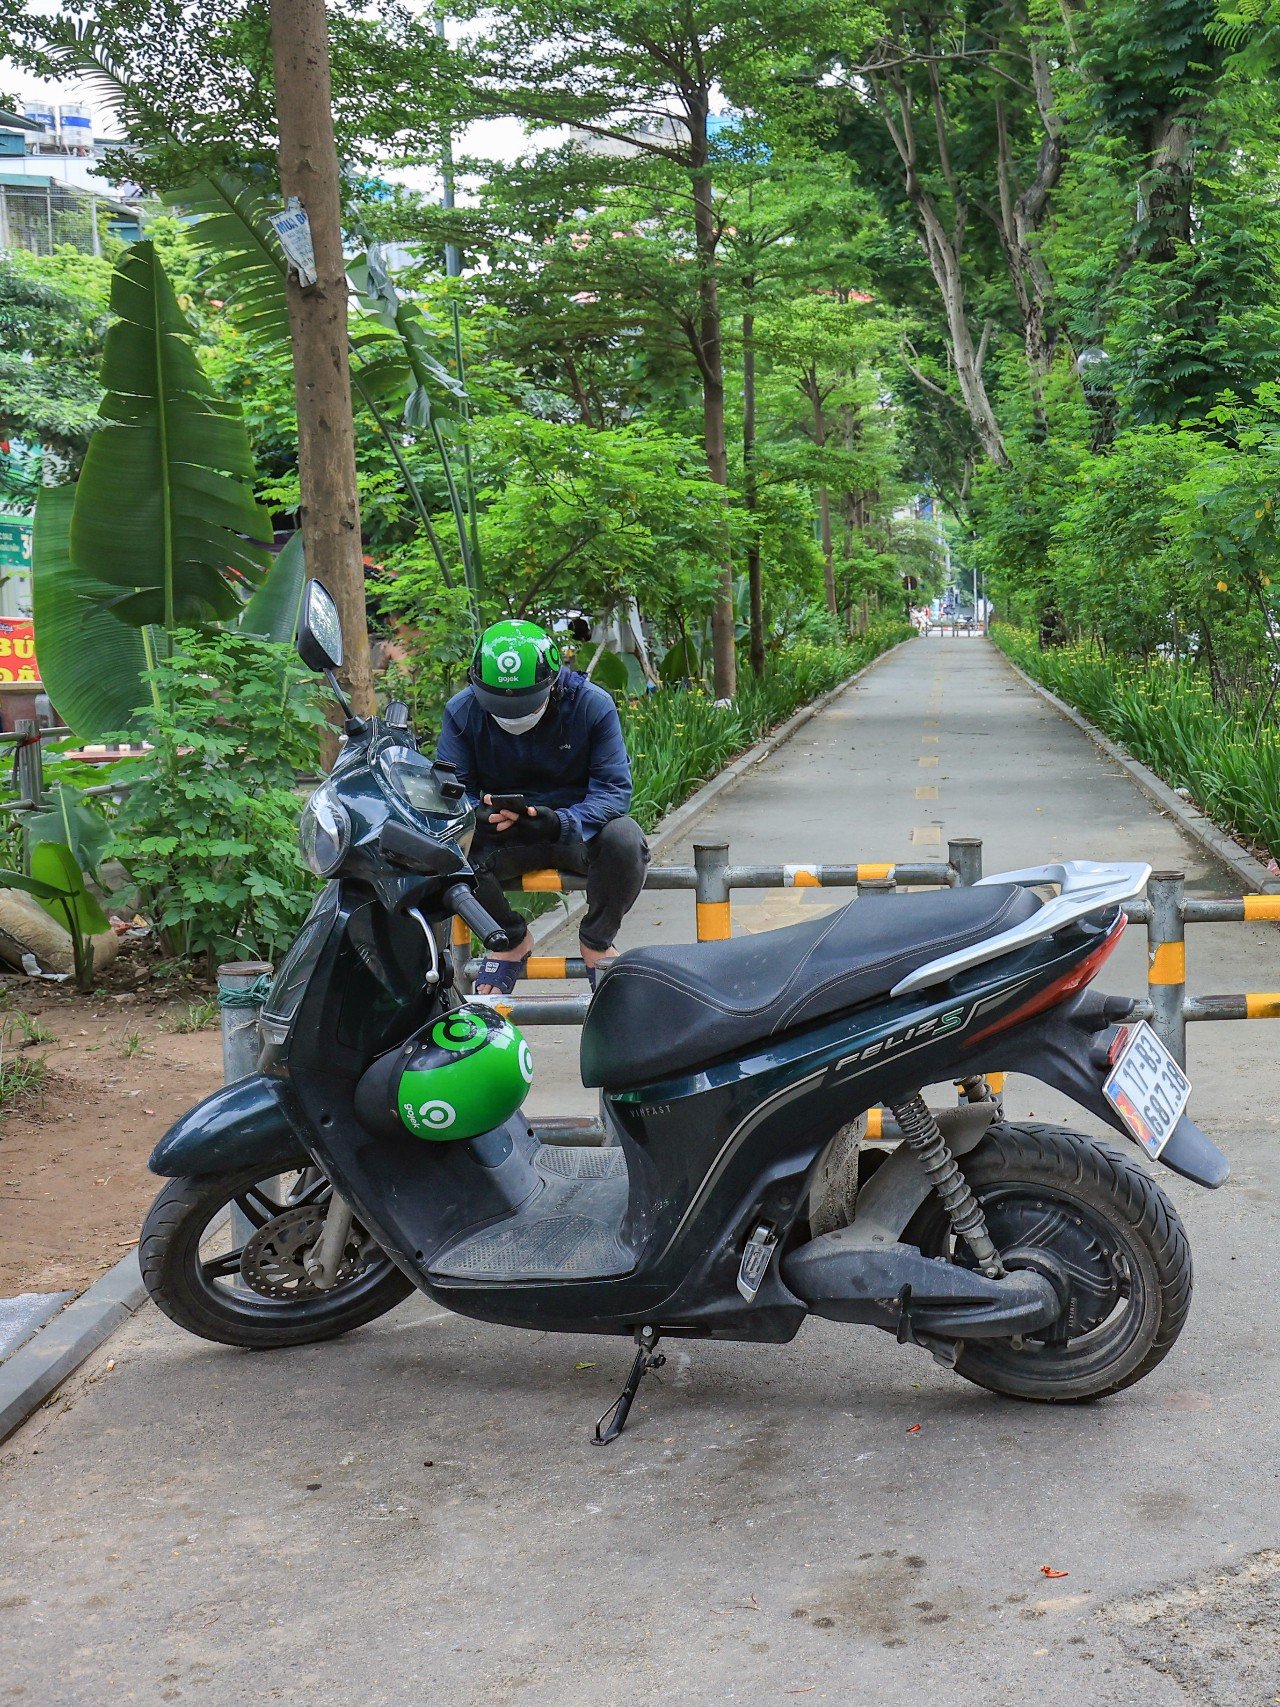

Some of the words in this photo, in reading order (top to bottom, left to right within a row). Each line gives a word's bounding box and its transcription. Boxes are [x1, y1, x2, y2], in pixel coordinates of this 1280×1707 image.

[497, 675, 519, 683] gojek
[1122, 1034, 1162, 1096] 17-B3
[630, 1104, 671, 1118] VINFAST
[1143, 1060, 1187, 1137] 687.38
[403, 1102, 420, 1129] gojek
